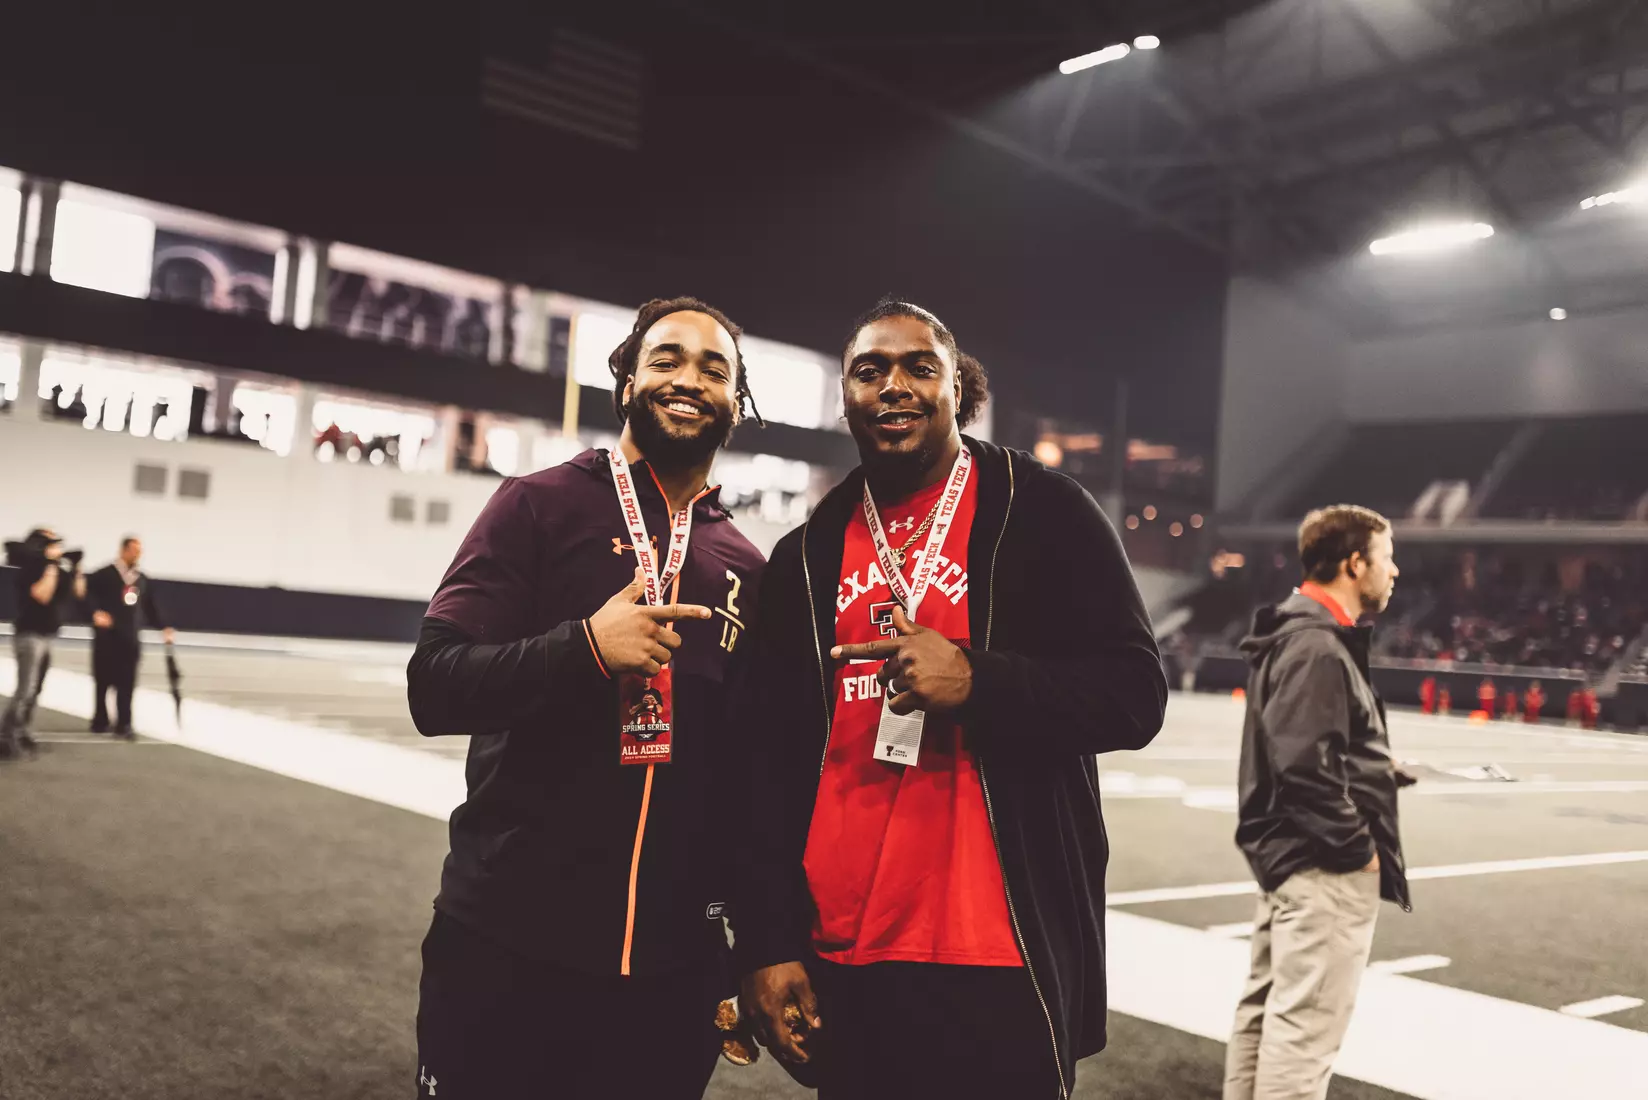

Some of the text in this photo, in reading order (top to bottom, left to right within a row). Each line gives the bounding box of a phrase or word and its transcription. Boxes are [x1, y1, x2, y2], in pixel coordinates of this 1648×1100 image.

[616, 472, 640, 527] TEXAS TECH
[941, 465, 968, 517] TEXAS TECH
[868, 513, 879, 535] TECH
[639, 550, 653, 574] TECH
[669, 549, 681, 570] TECH
[881, 553, 909, 601] TEXAS TECH
[913, 542, 940, 597] TEXAS TECH
[726, 569, 741, 616] 2
[836, 561, 888, 614] EXA
[842, 673, 882, 702] FOO
[622, 723, 670, 733] SPRING SERIES
[621, 744, 670, 756] ALL ACCESS
